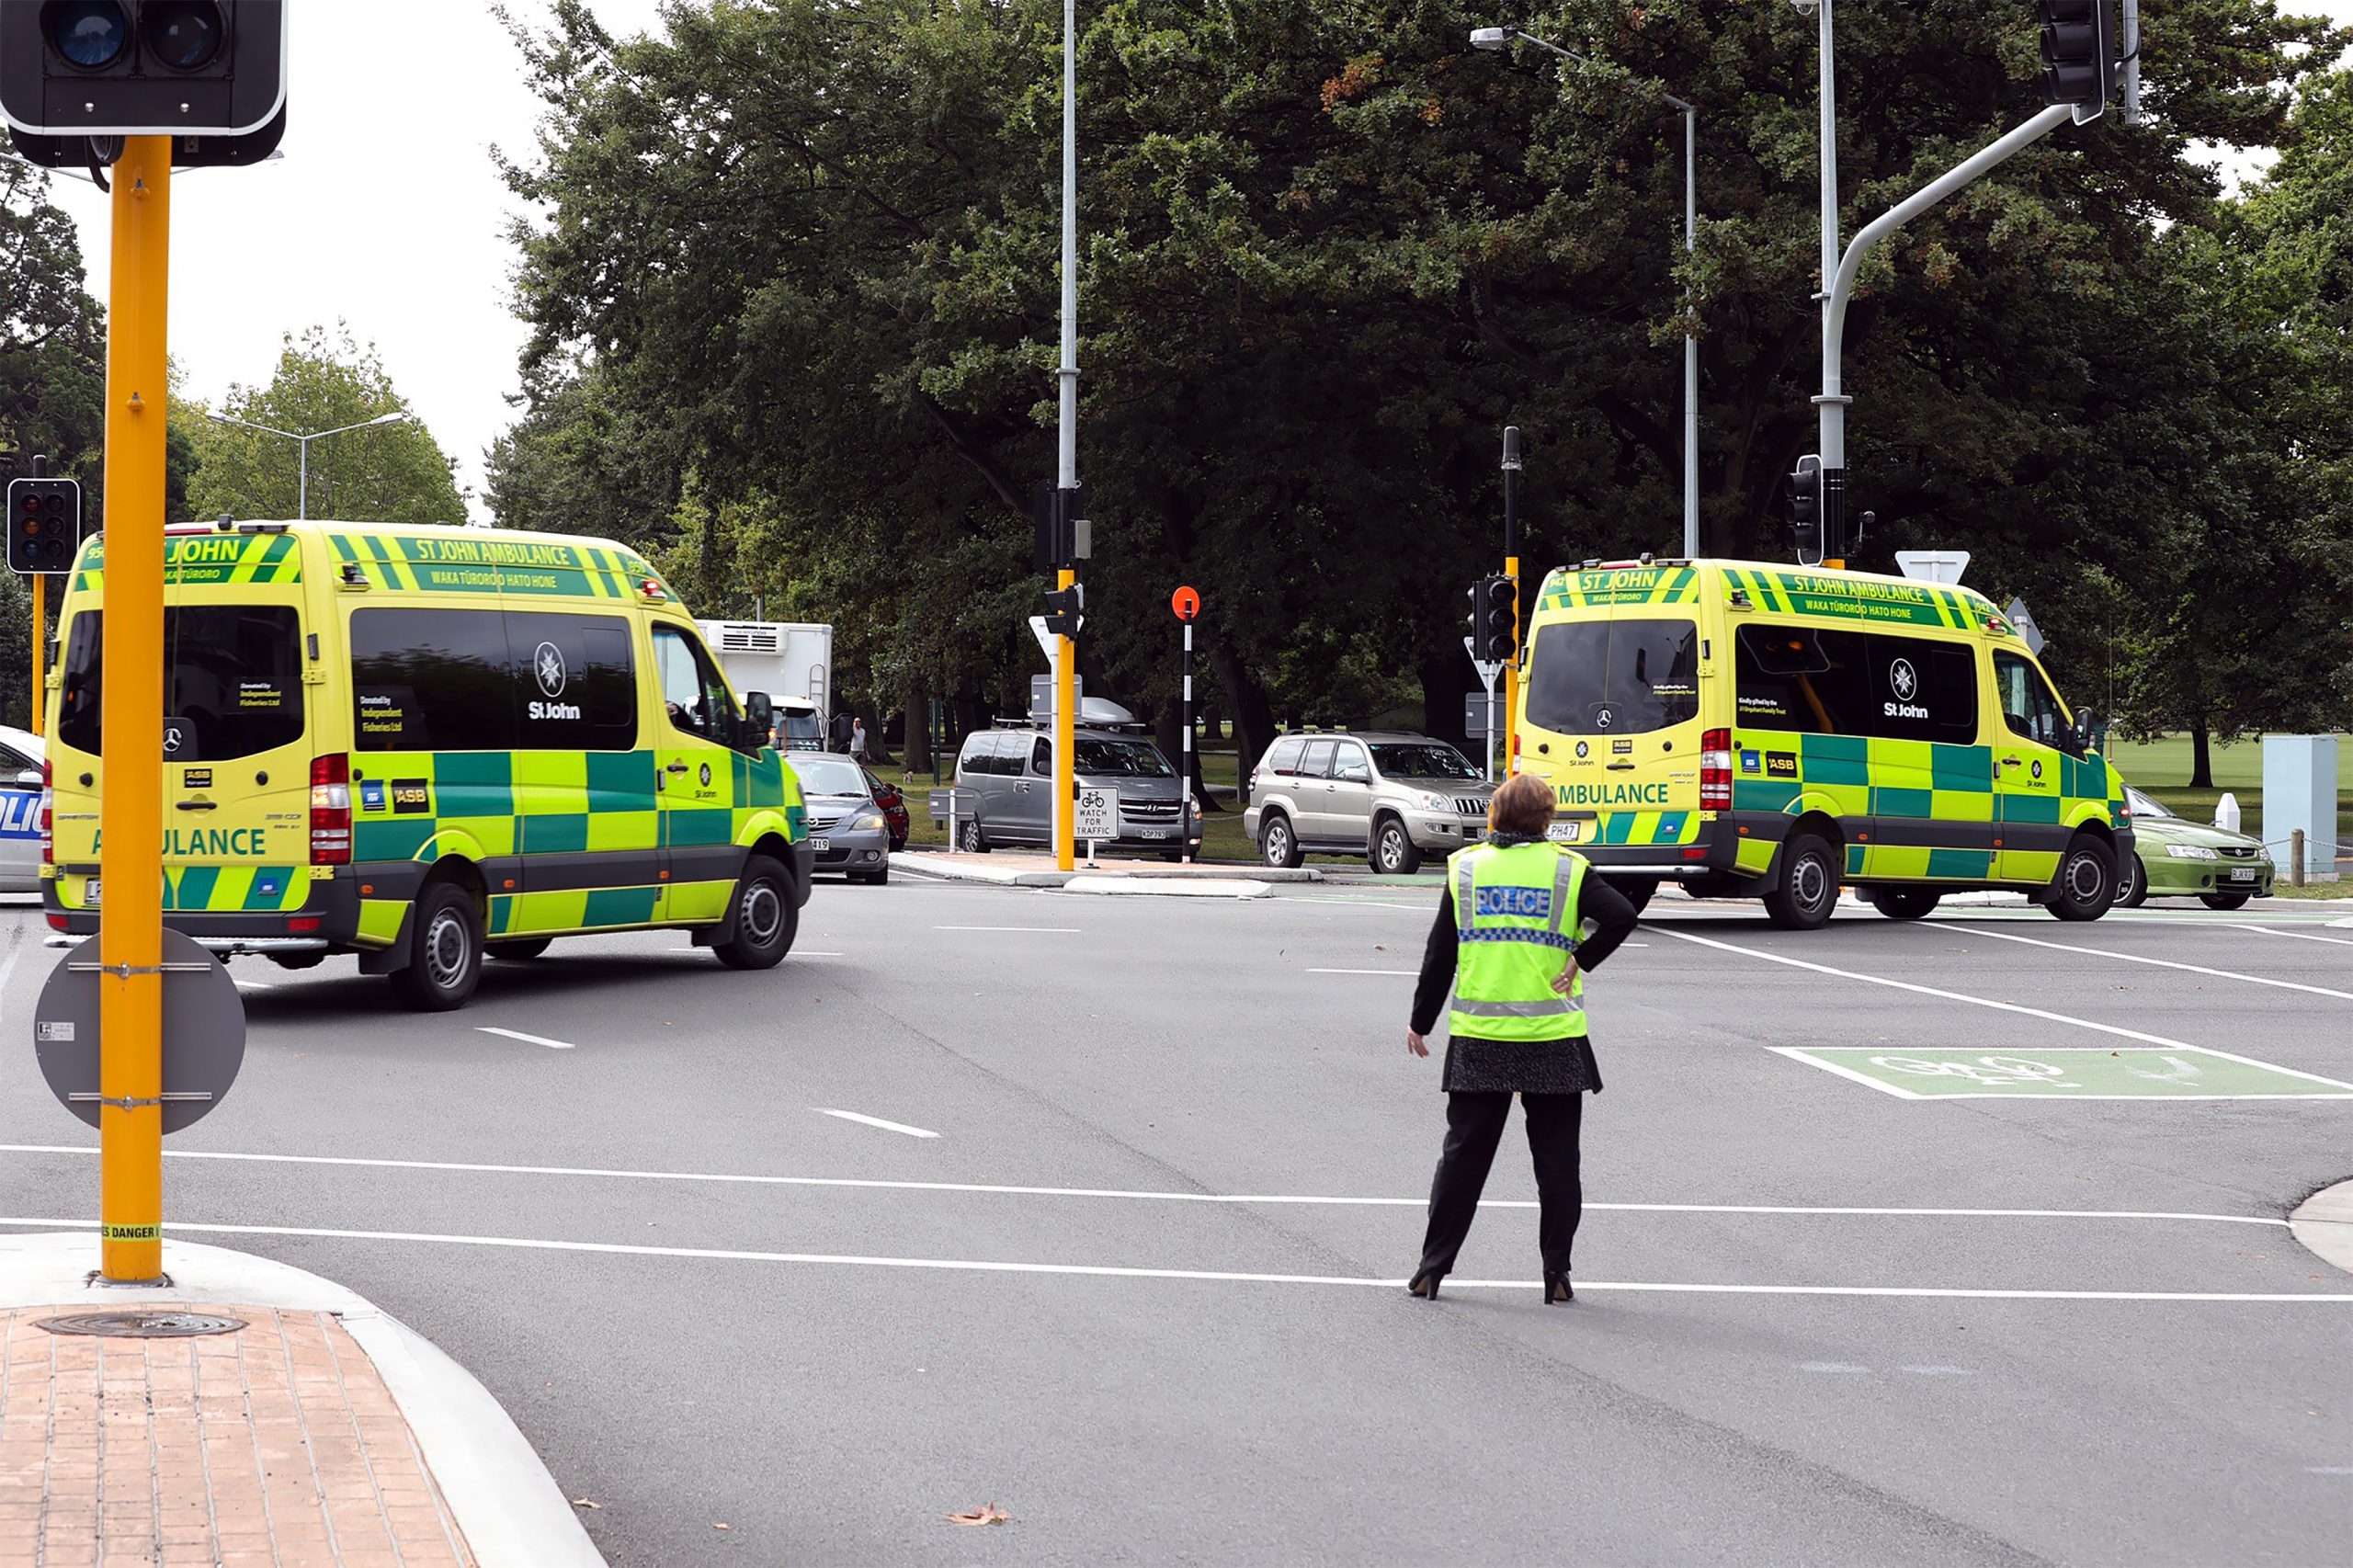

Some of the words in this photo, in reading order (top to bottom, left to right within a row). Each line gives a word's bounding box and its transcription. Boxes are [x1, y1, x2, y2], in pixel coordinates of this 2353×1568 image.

[167, 540, 240, 562] JOHN
[415, 540, 436, 559] ST
[438, 540, 480, 562] JOHN
[482, 542, 571, 565] AMBULANCE
[431, 571, 460, 585] WAKA
[506, 574, 530, 587] HATO
[532, 575, 557, 588] HONE
[1582, 574, 1604, 590] ST
[1605, 571, 1656, 589] JOHN
[1794, 575, 1810, 591] ST
[1813, 577, 1847, 596] JOHN
[1849, 580, 1924, 602] AMBULANCE
[1593, 595, 1611, 603] WAKA
[1805, 599, 1829, 611] WAKA
[1869, 606, 1890, 617] HATO
[1891, 608, 1912, 619] HONE
[361, 707, 403, 720] Independent
[529, 701, 544, 720] St
[545, 702, 581, 720] John
[1884, 702, 1898, 716] St
[1898, 704, 1928, 719] John
[1769, 758, 1794, 770] ASB
[395, 790, 426, 803] ASB
[1476, 888, 1551, 915] POLICE
[112, 1227, 154, 1238] DANGER
